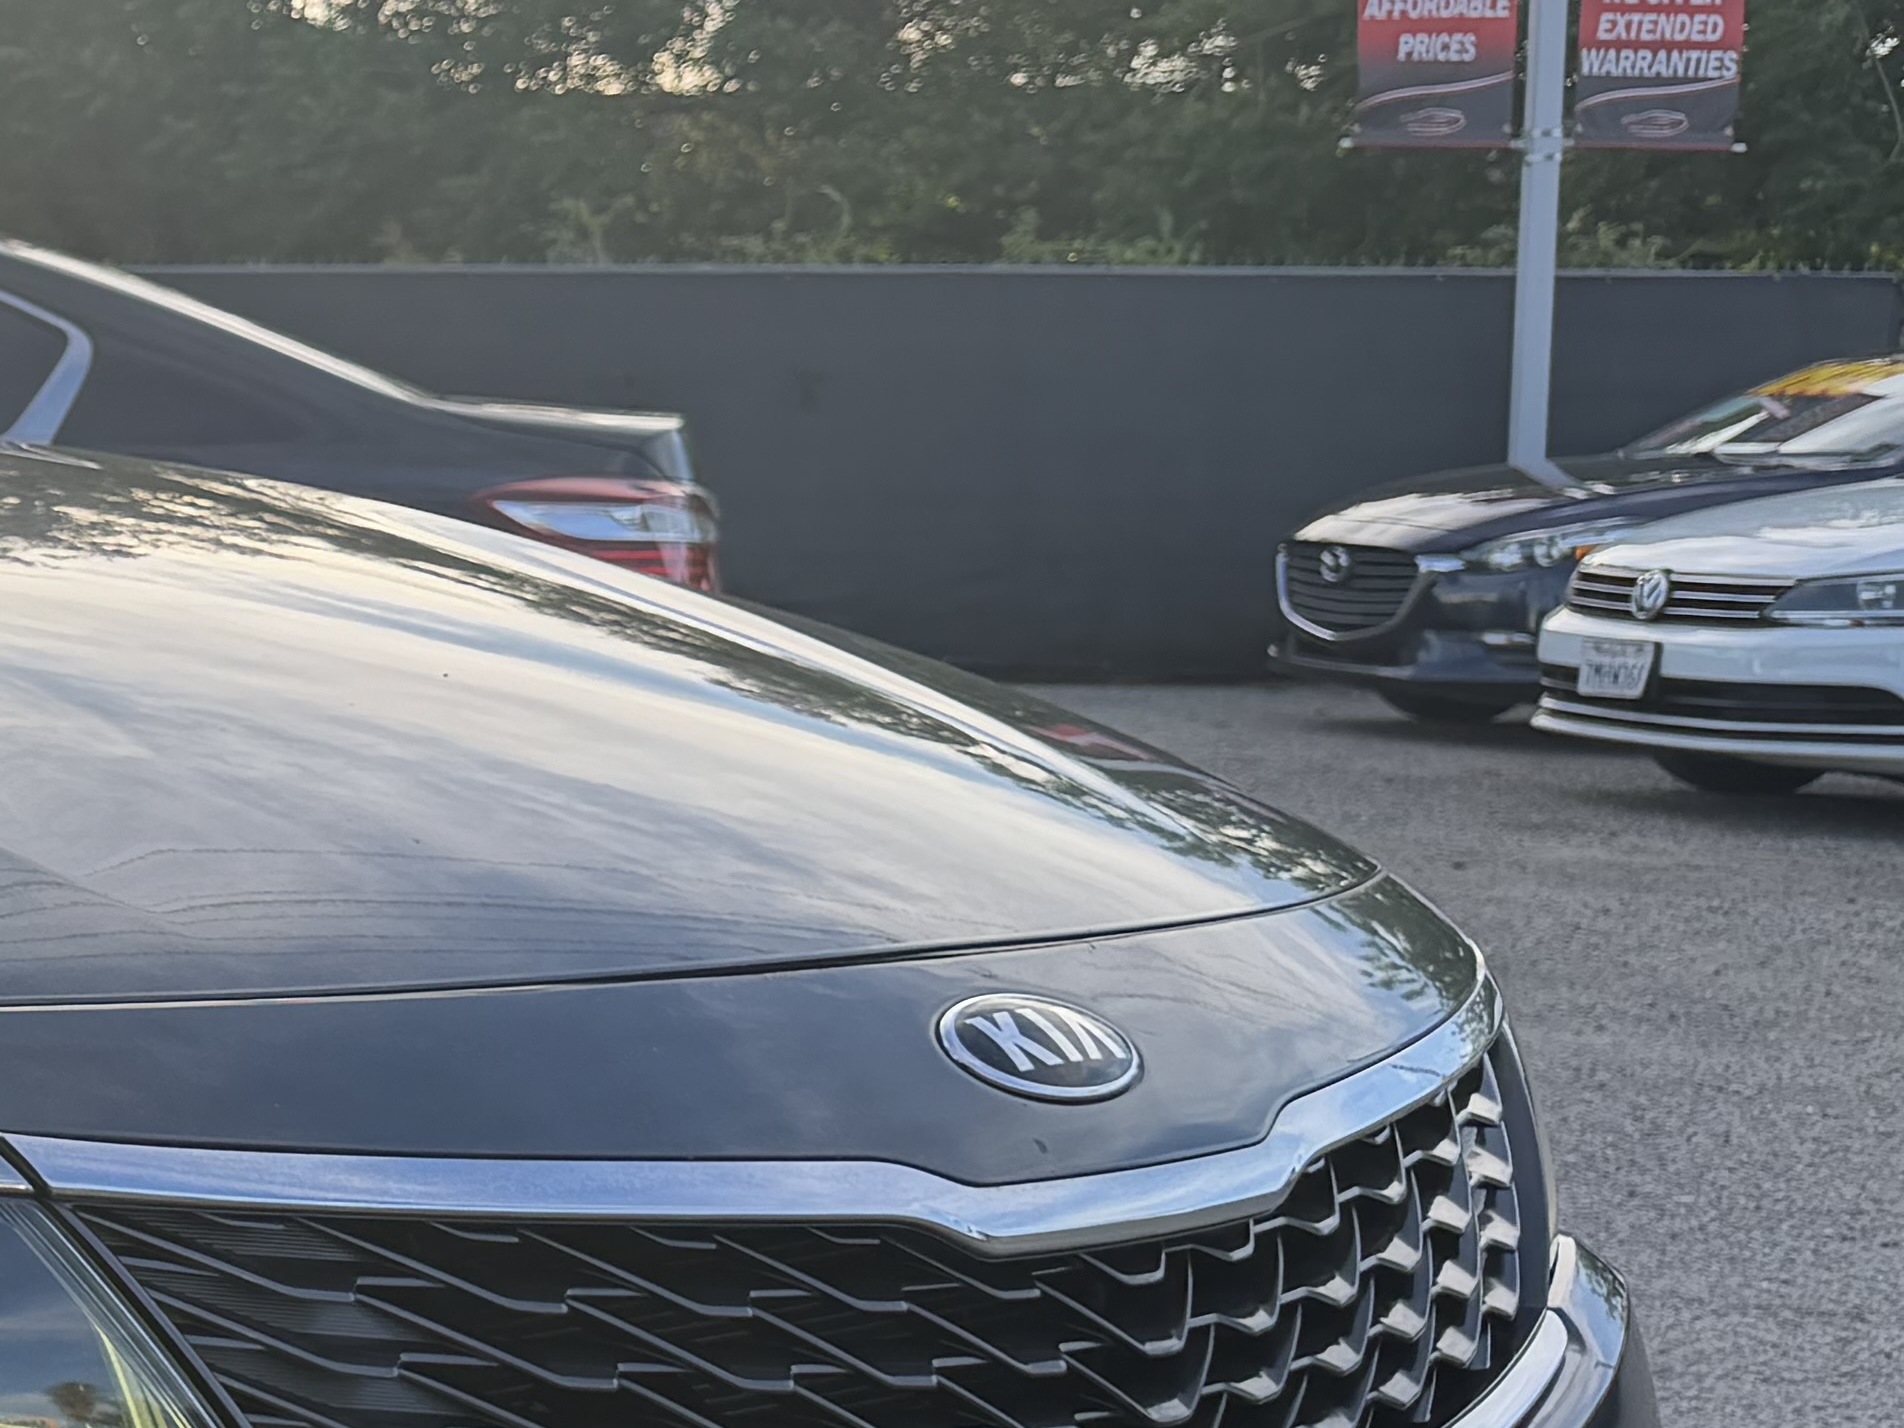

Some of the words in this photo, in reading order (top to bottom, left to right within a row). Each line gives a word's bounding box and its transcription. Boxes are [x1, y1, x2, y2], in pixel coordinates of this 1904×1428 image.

[1596, 12, 1725, 42] EXTENDED
[1397, 32, 1477, 62] PRICES
[1580, 48, 1739, 78] WARRANTIES
[965, 1006, 1127, 1072] KIA
